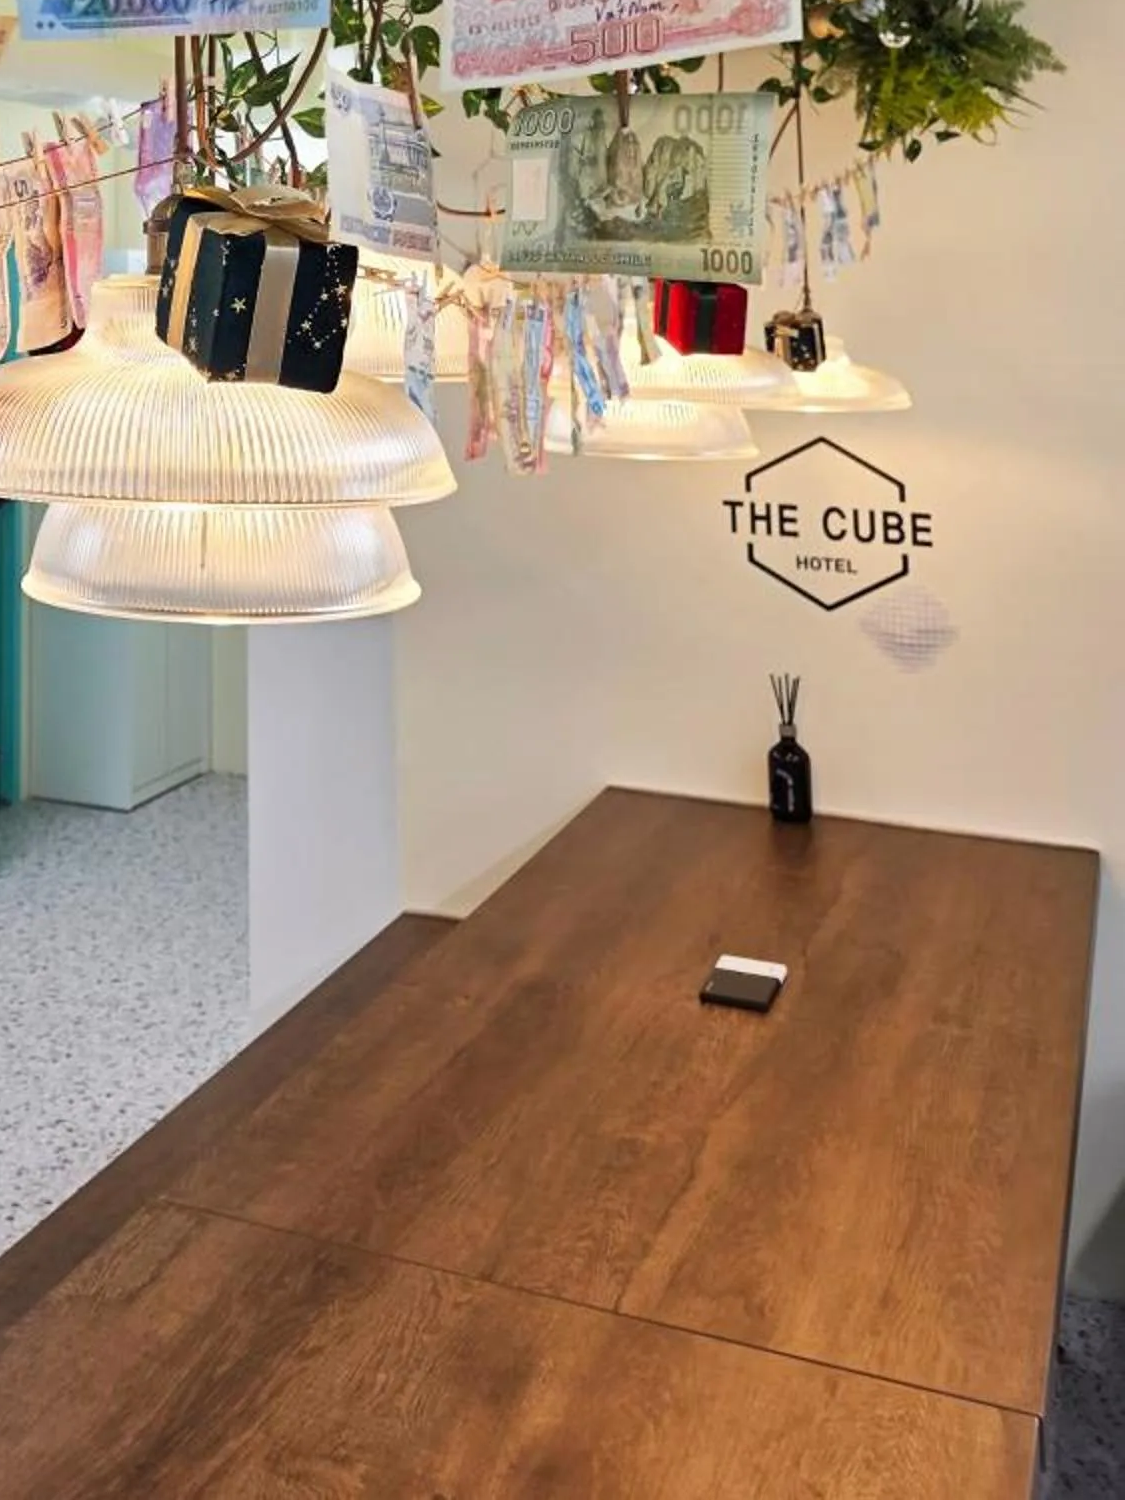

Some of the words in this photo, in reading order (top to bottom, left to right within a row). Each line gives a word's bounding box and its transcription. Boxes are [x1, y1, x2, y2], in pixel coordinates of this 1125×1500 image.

[570, 16, 663, 65] 500
[700, 248, 754, 276] 1000
[723, 500, 799, 539] THE
[822, 506, 934, 548] CUBE
[796, 555, 858, 575] HOTEL
